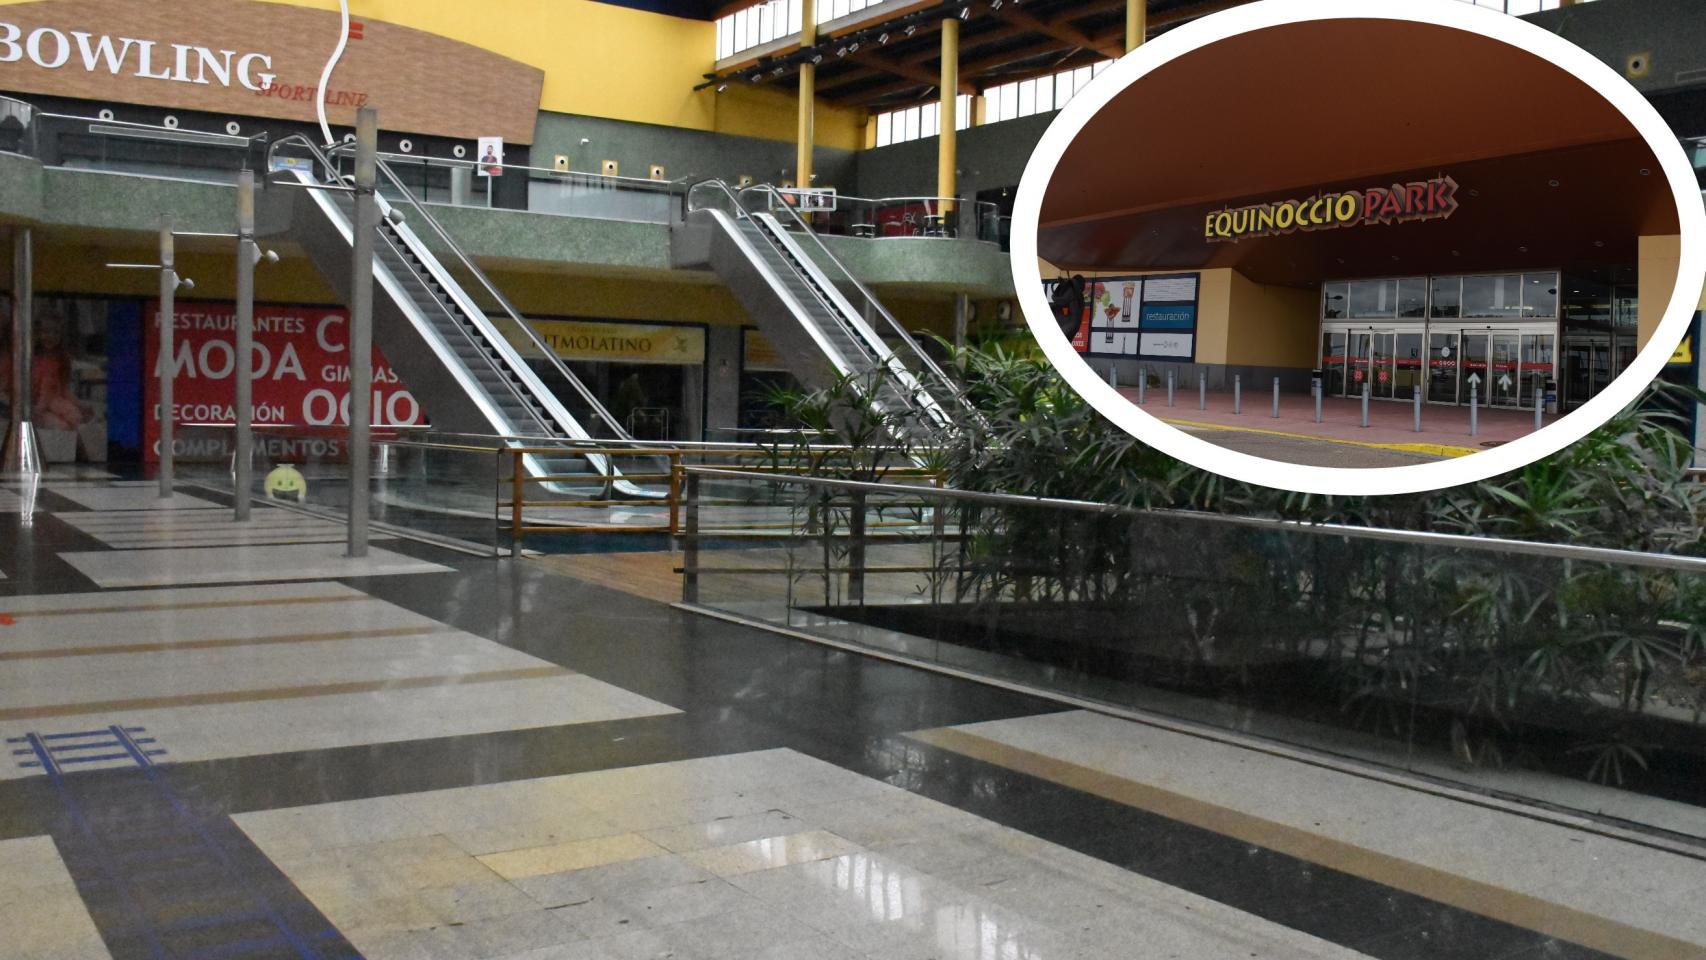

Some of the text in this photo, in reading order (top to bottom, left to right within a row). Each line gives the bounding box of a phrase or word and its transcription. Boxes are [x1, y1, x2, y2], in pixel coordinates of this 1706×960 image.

[0, 22, 277, 92] BOWLING
[254, 79, 369, 107] SPORT LINE
[1204, 180, 1449, 238] EQUINOCCIO PARK
[154, 312, 305, 333] RESTAUNTES
[1146, 311, 1190, 321] restauración
[531, 334, 653, 353] ITMOLATINO
[154, 338, 306, 381] MODA
[154, 401, 285, 422] DECORAIÓN
[153, 437, 339, 458] COMPLMENTOS
